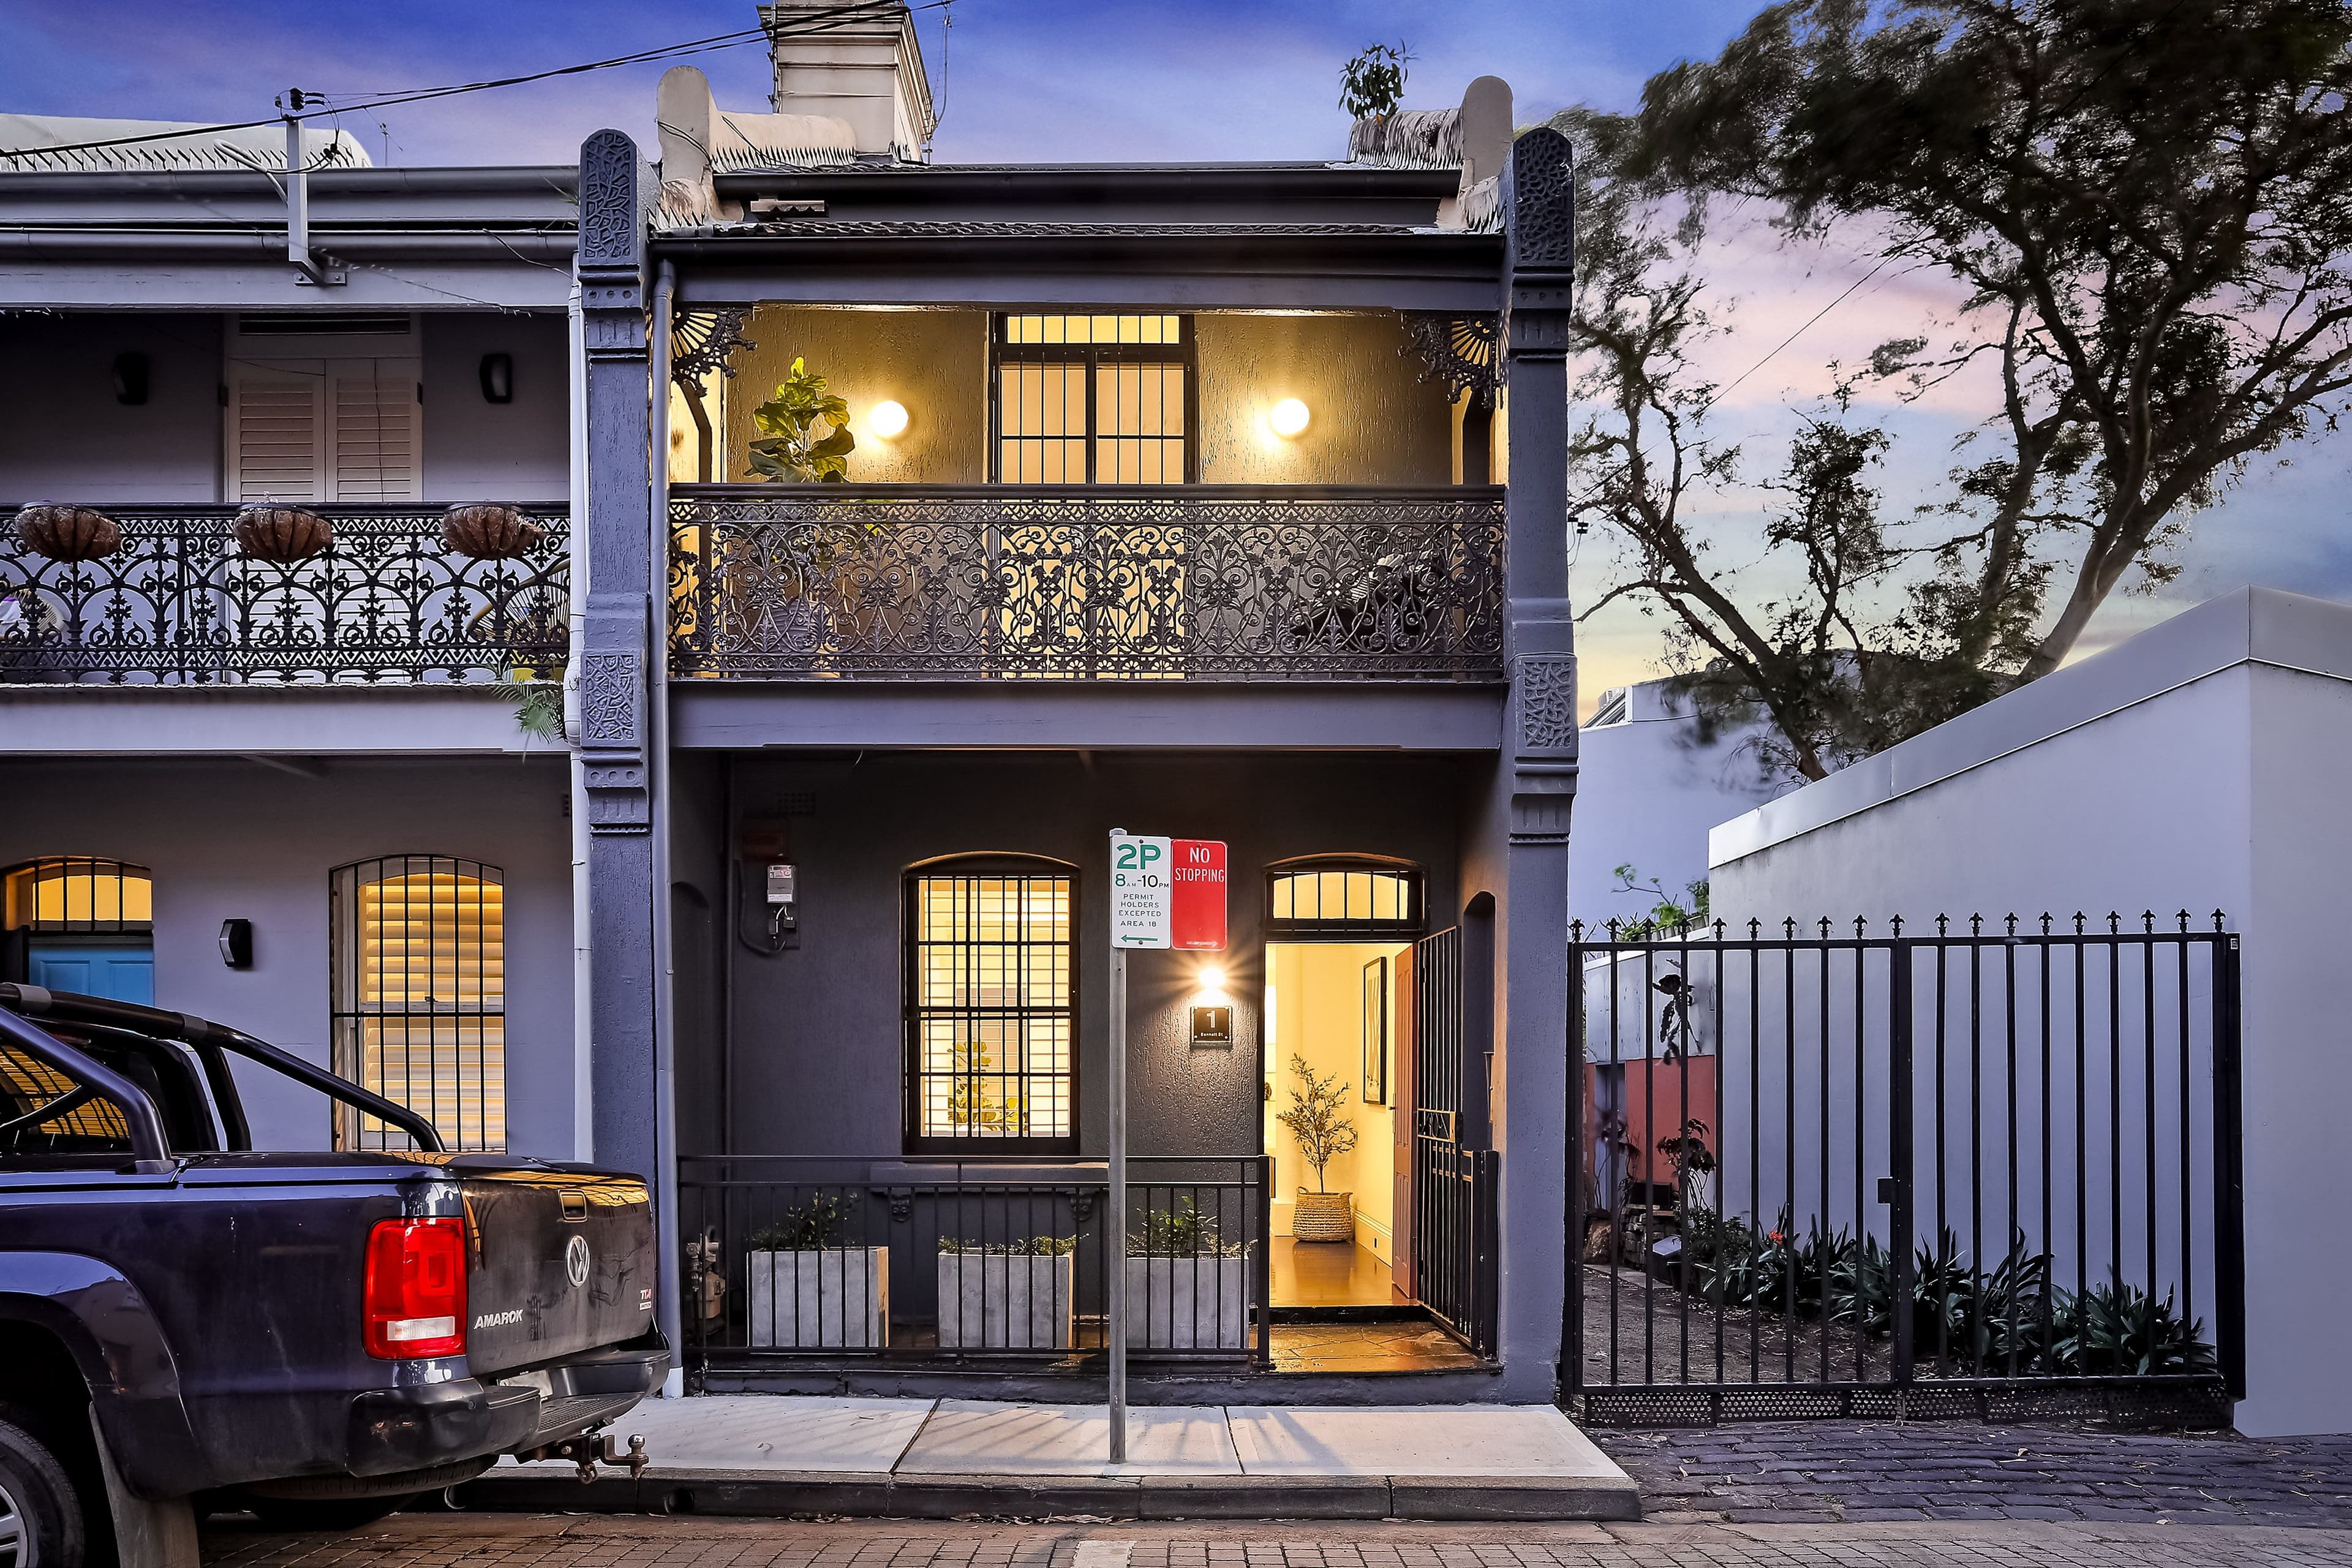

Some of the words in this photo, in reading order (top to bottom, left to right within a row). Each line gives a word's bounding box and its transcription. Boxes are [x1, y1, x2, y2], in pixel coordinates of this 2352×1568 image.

[1117, 843, 1161, 870] 2P
[1189, 847, 1210, 863] NO
[1175, 867, 1224, 882] STOPPING
[1206, 1010, 1216, 1028] 1
[473, 1309, 523, 1330] AMAROK
